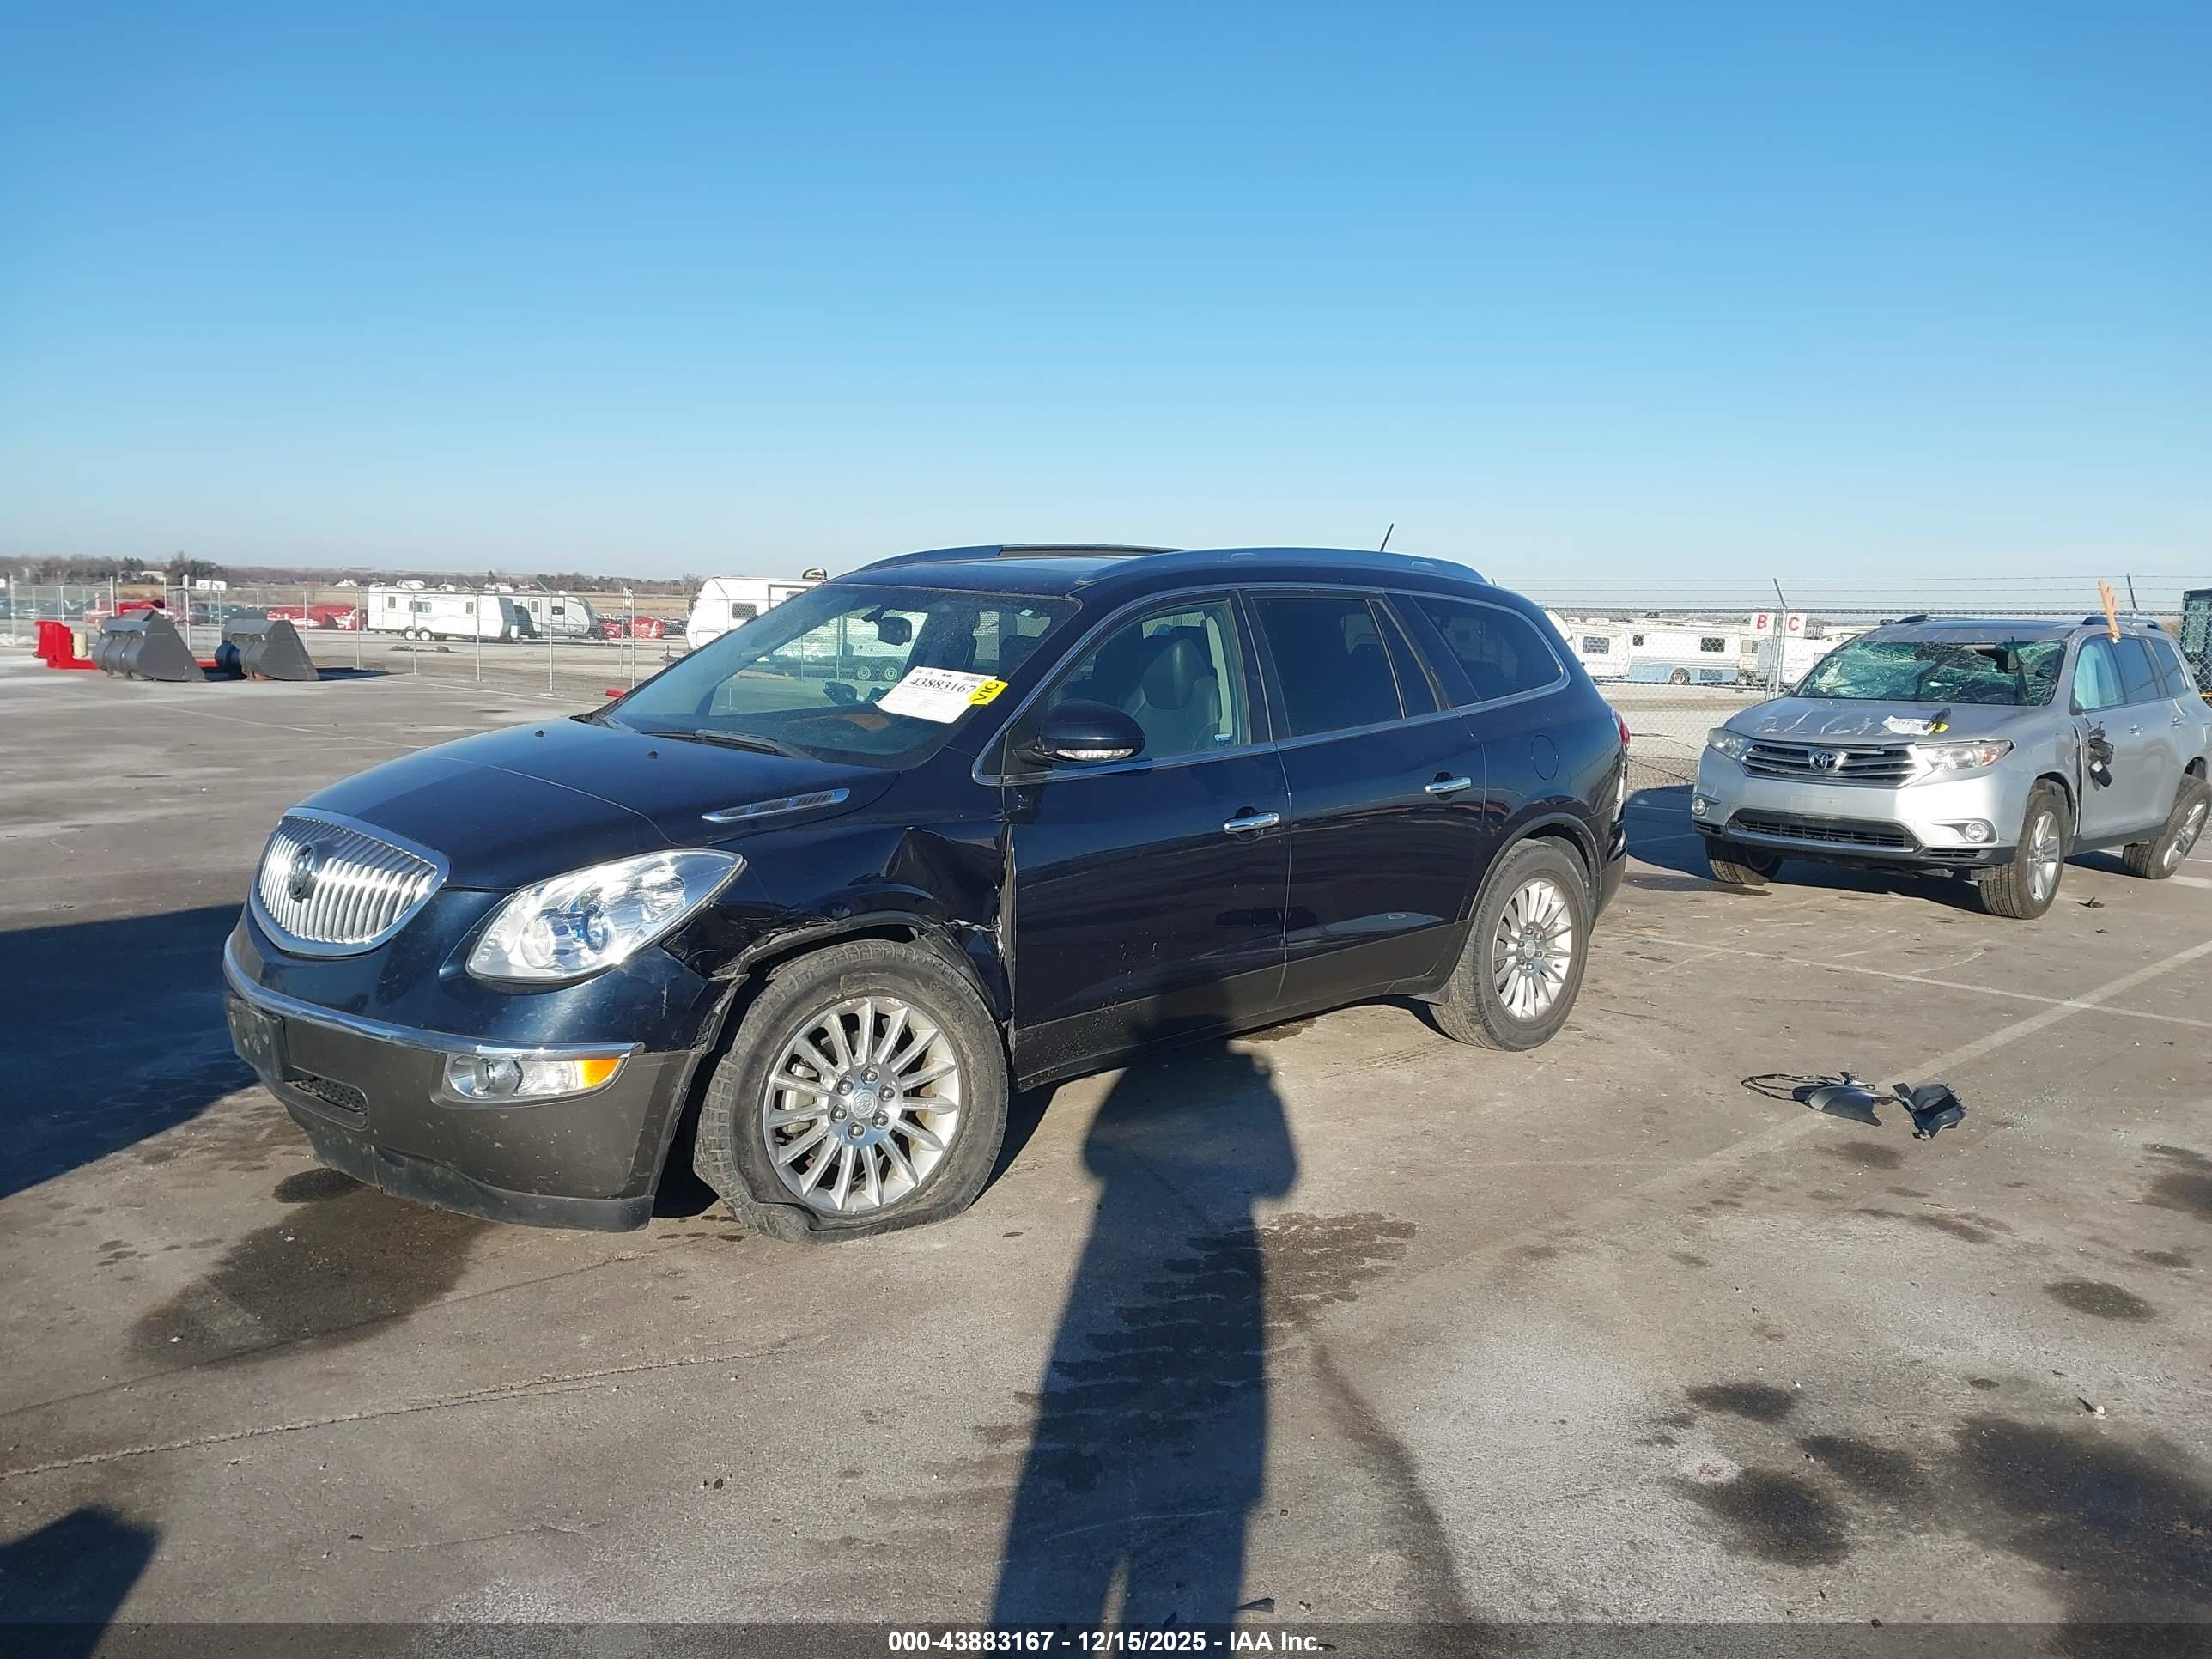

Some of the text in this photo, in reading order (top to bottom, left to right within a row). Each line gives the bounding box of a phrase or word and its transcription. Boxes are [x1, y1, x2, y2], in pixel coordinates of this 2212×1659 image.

[1757, 615, 1767, 629] B
[1788, 617, 1800, 631] C
[909, 677, 978, 694] 43883167
[973, 682, 1000, 702] VIC
